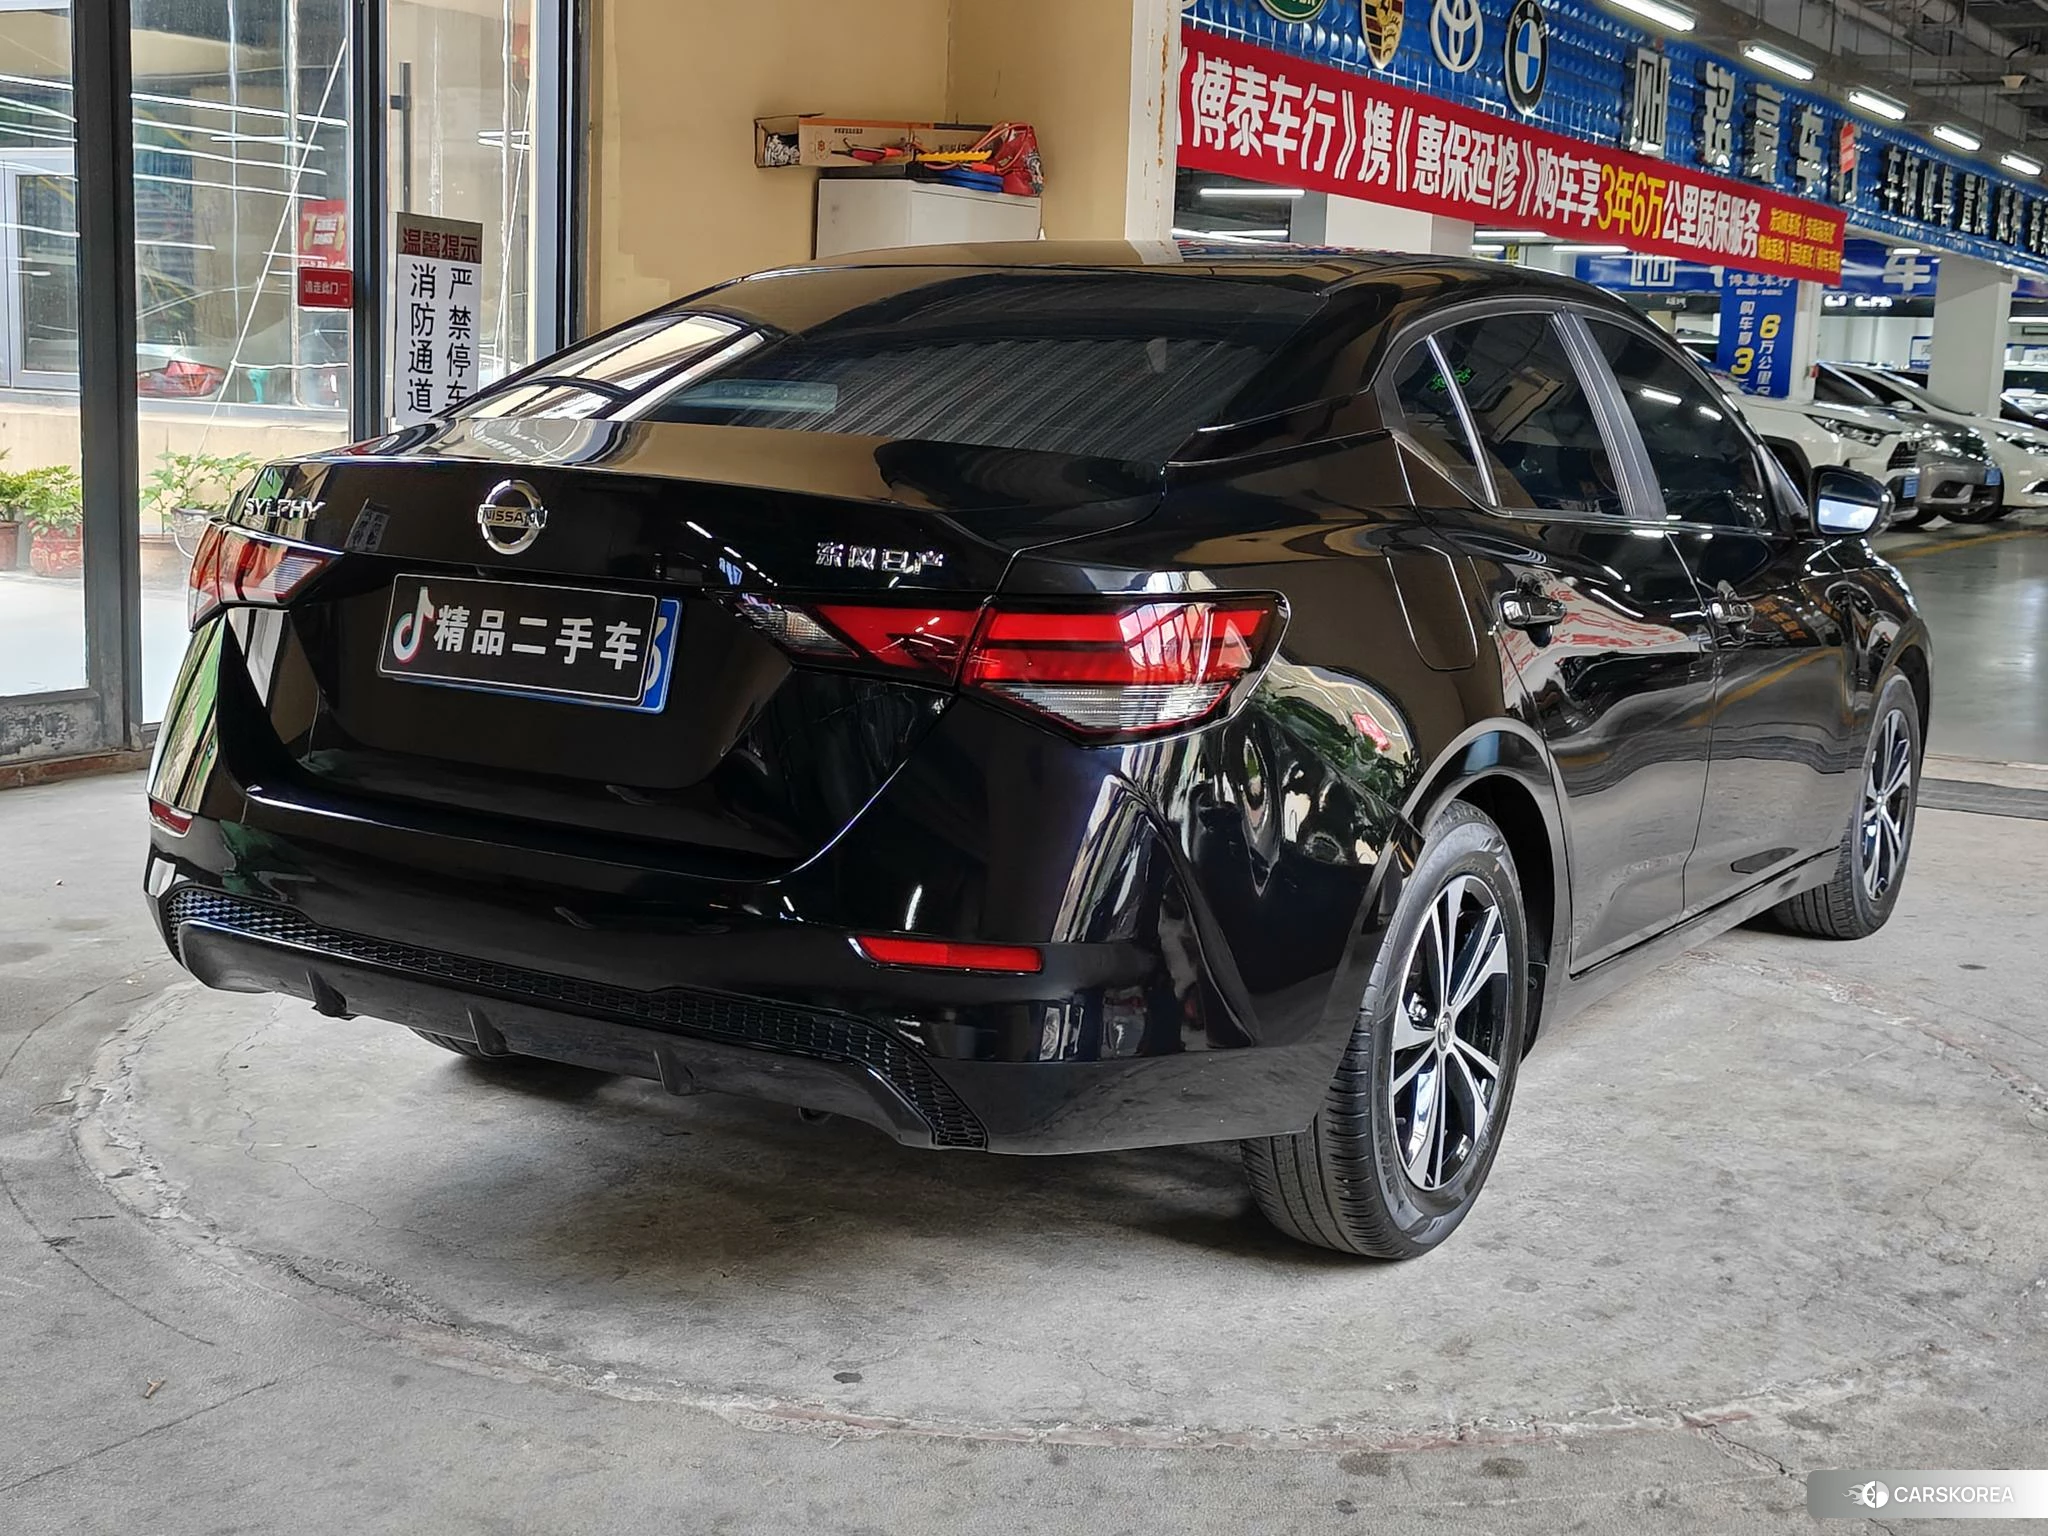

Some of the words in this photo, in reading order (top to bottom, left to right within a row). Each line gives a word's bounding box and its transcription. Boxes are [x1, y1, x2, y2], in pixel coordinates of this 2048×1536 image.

[403, 227, 479, 264] 温馨提示
[407, 263, 437, 415] 消防通道
[445, 267, 474, 409] 严禁停车
[1730, 300, 1756, 382] 购车享3
[243, 497, 327, 521] SYLPHY
[482, 507, 546, 528] NISSAN
[816, 541, 944, 575] 东风日产
[433, 605, 642, 670] 精品二手车
